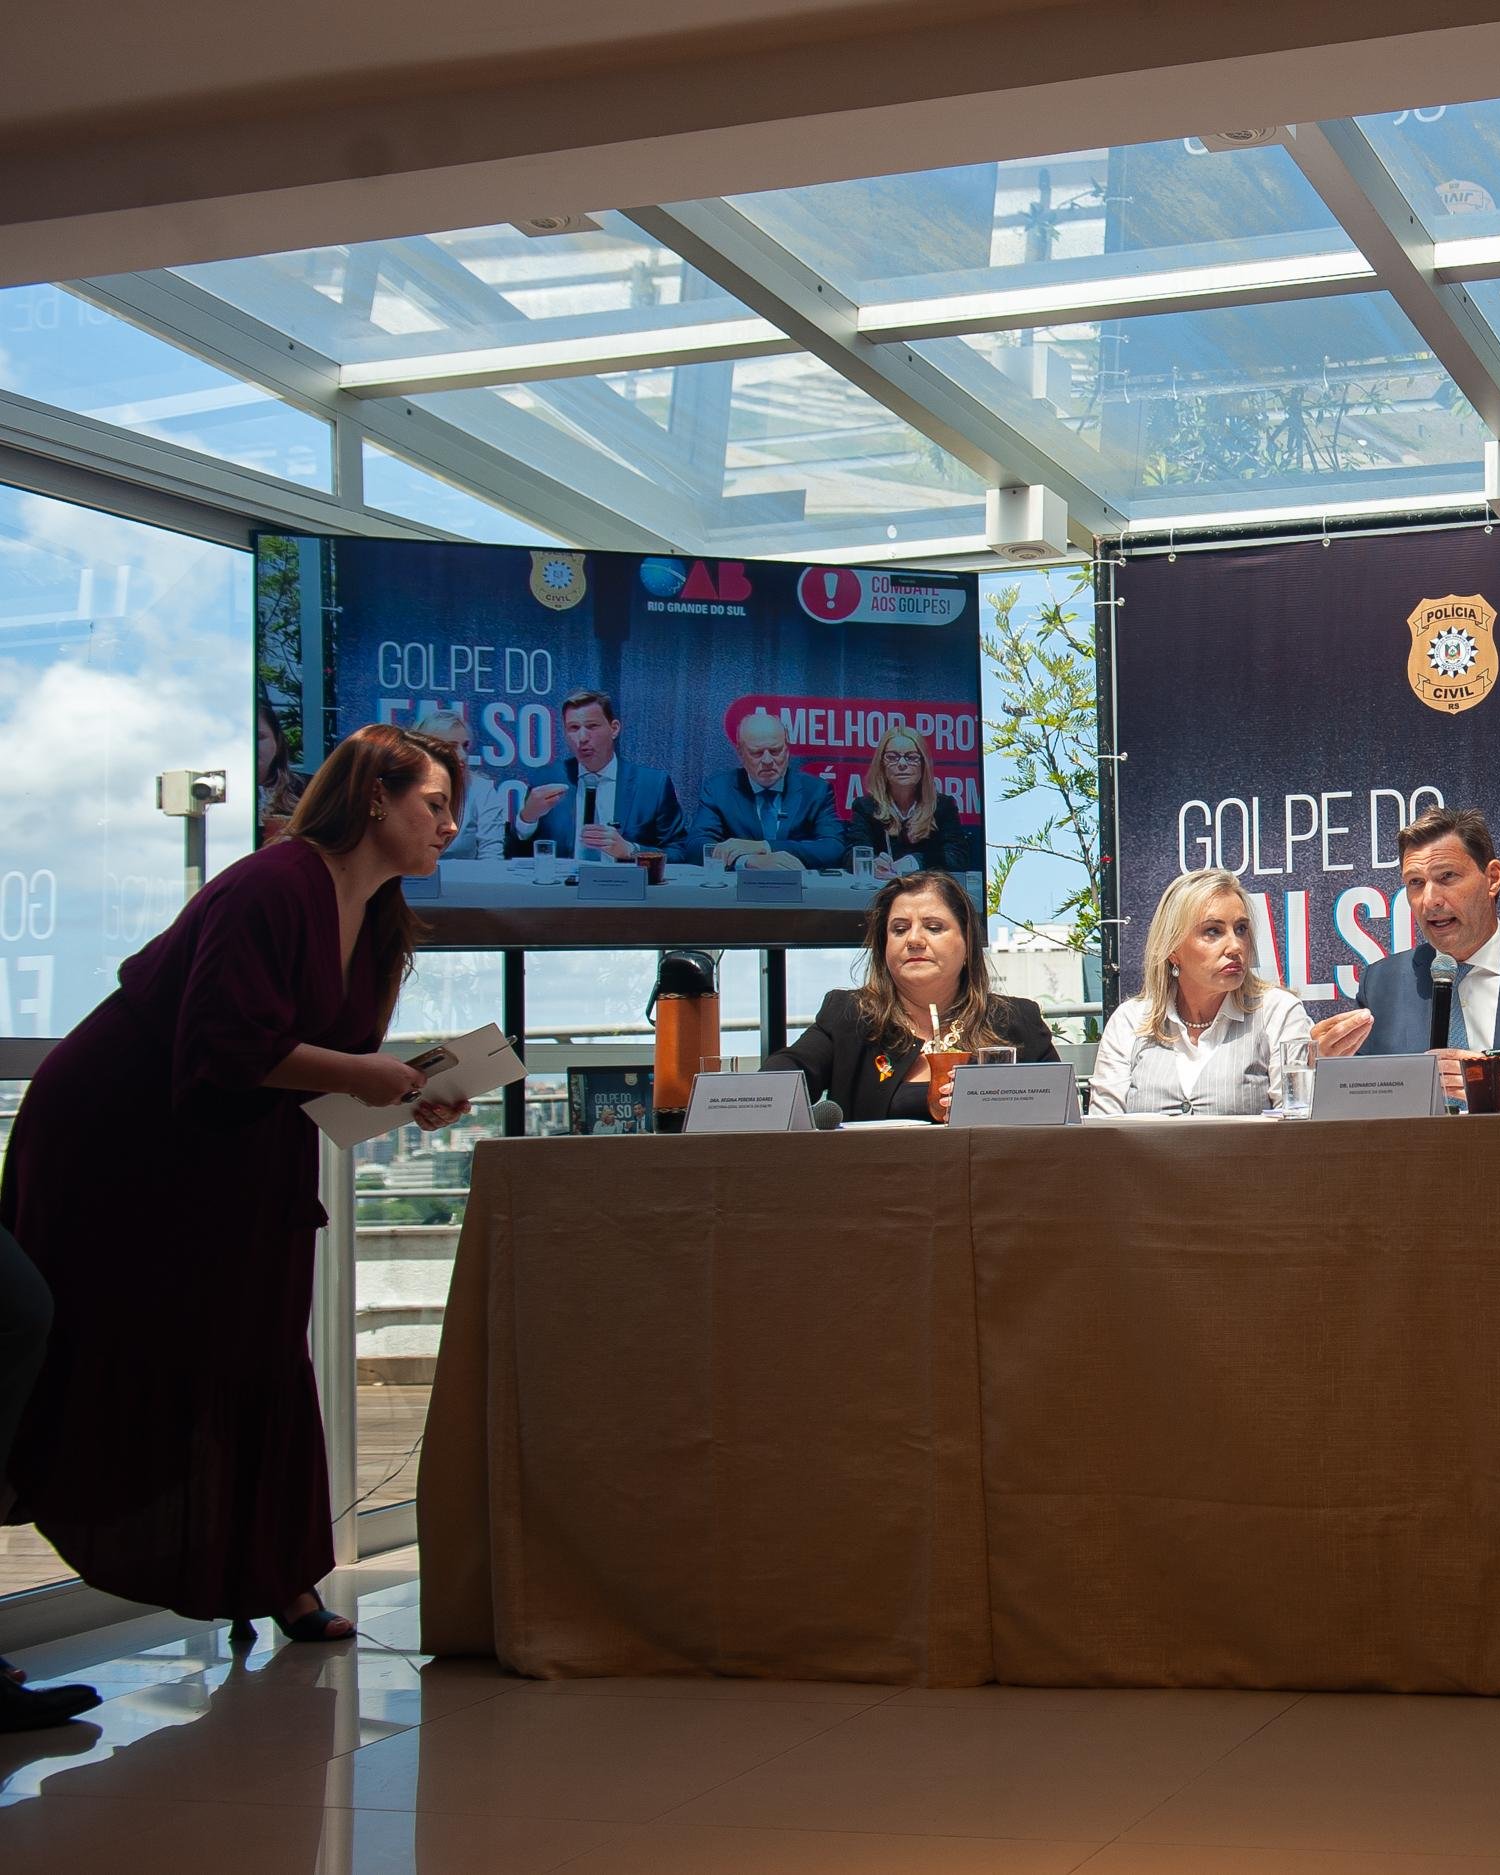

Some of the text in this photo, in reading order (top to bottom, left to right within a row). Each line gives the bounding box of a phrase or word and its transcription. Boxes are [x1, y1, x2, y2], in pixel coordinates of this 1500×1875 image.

[647, 601, 747, 617] RIO GRANDE DO SUL
[871, 596, 951, 615] AOS GOLPES!
[1426, 604, 1477, 622] POLÍCIA
[378, 641, 552, 696] GOLPE DO
[1433, 687, 1474, 699] CIVIL
[1178, 791, 1354, 877] GOLPE
